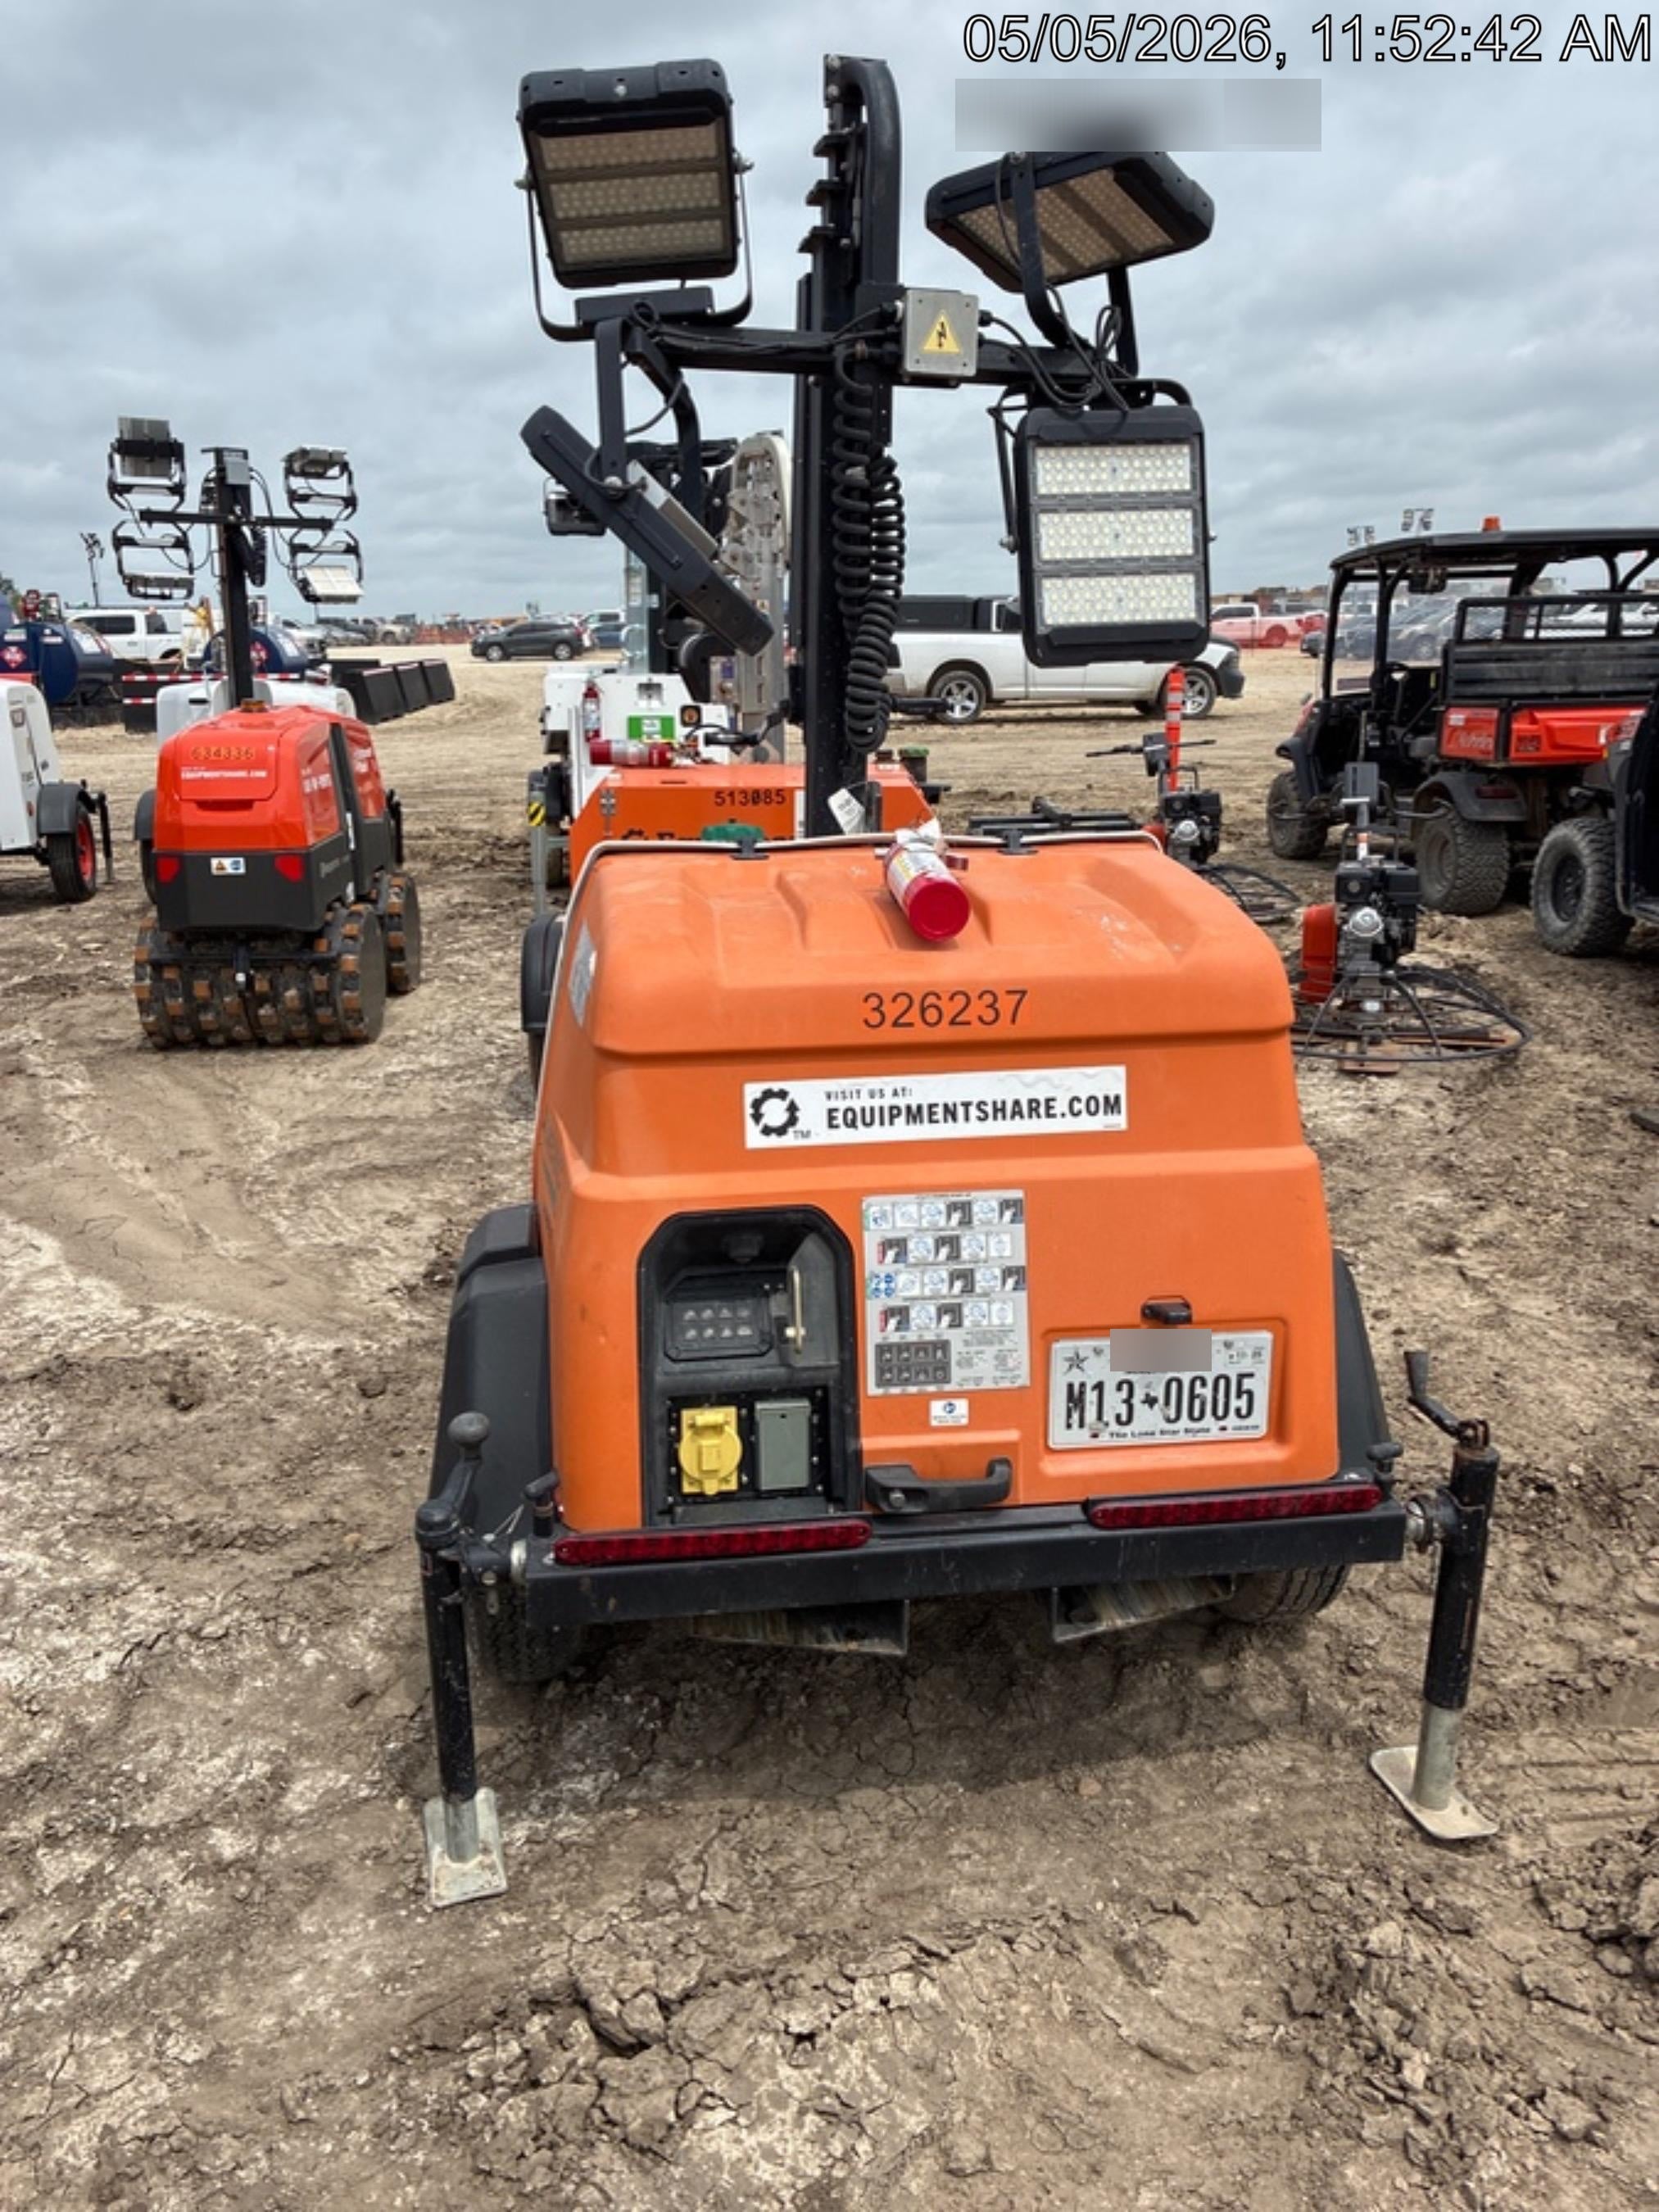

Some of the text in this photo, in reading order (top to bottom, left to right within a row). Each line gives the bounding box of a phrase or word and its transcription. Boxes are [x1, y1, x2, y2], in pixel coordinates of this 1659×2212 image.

[714, 788, 786, 806] 513085
[863, 989, 1028, 1029] 326237
[825, 1086, 913, 1101] VISIT US AT:
[827, 1093, 1122, 1131] EQUIPMENTSHARE.COM
